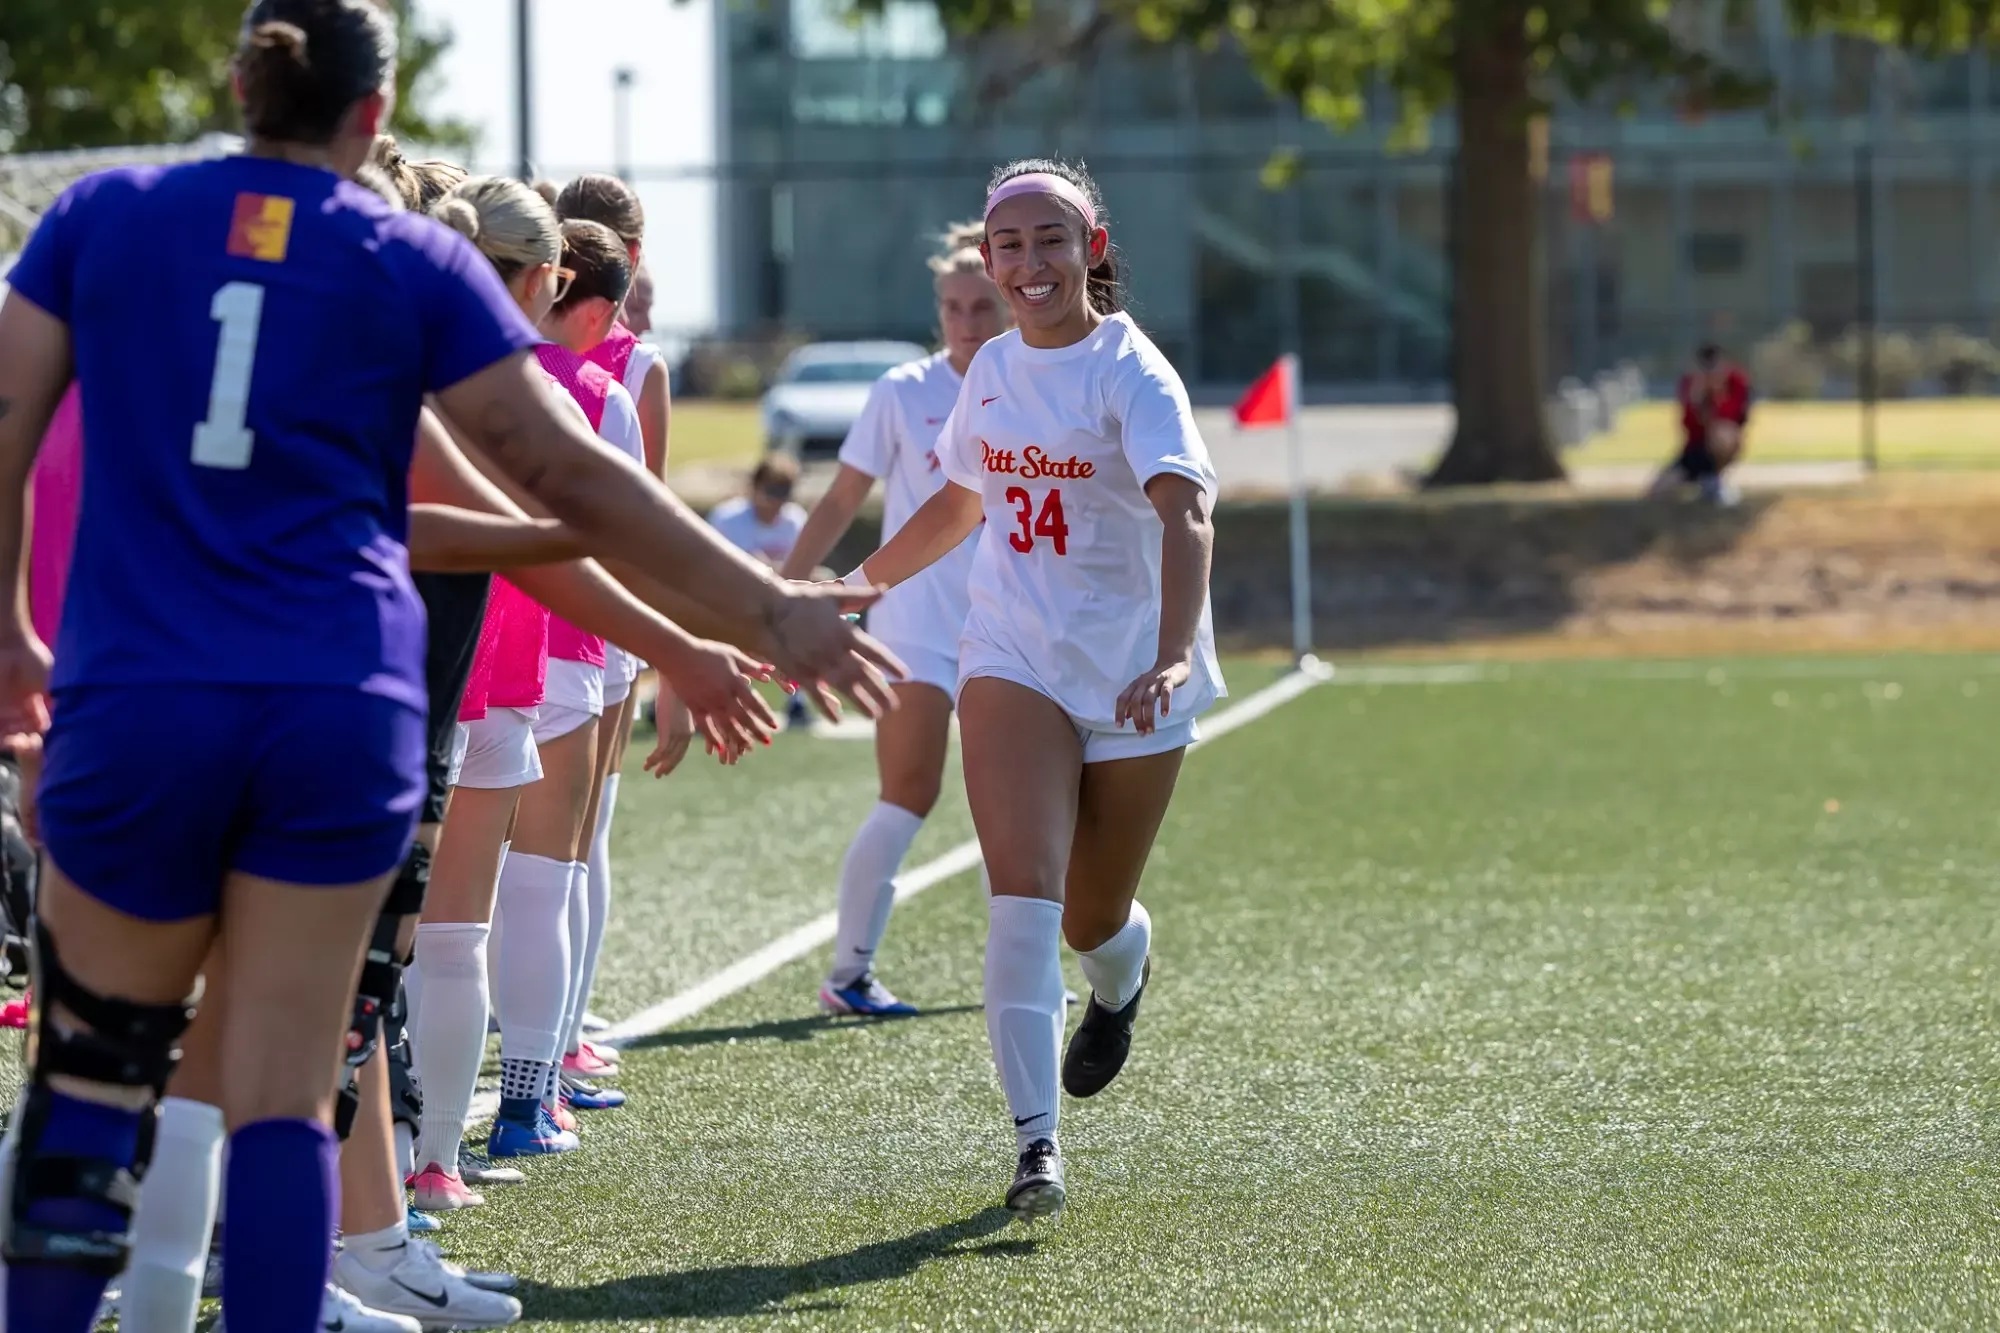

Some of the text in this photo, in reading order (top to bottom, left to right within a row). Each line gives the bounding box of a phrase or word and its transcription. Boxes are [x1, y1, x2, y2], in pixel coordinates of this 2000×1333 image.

[190, 280, 265, 470] 1
[1019, 445, 1097, 479] State
[1005, 486, 1069, 556] 34
